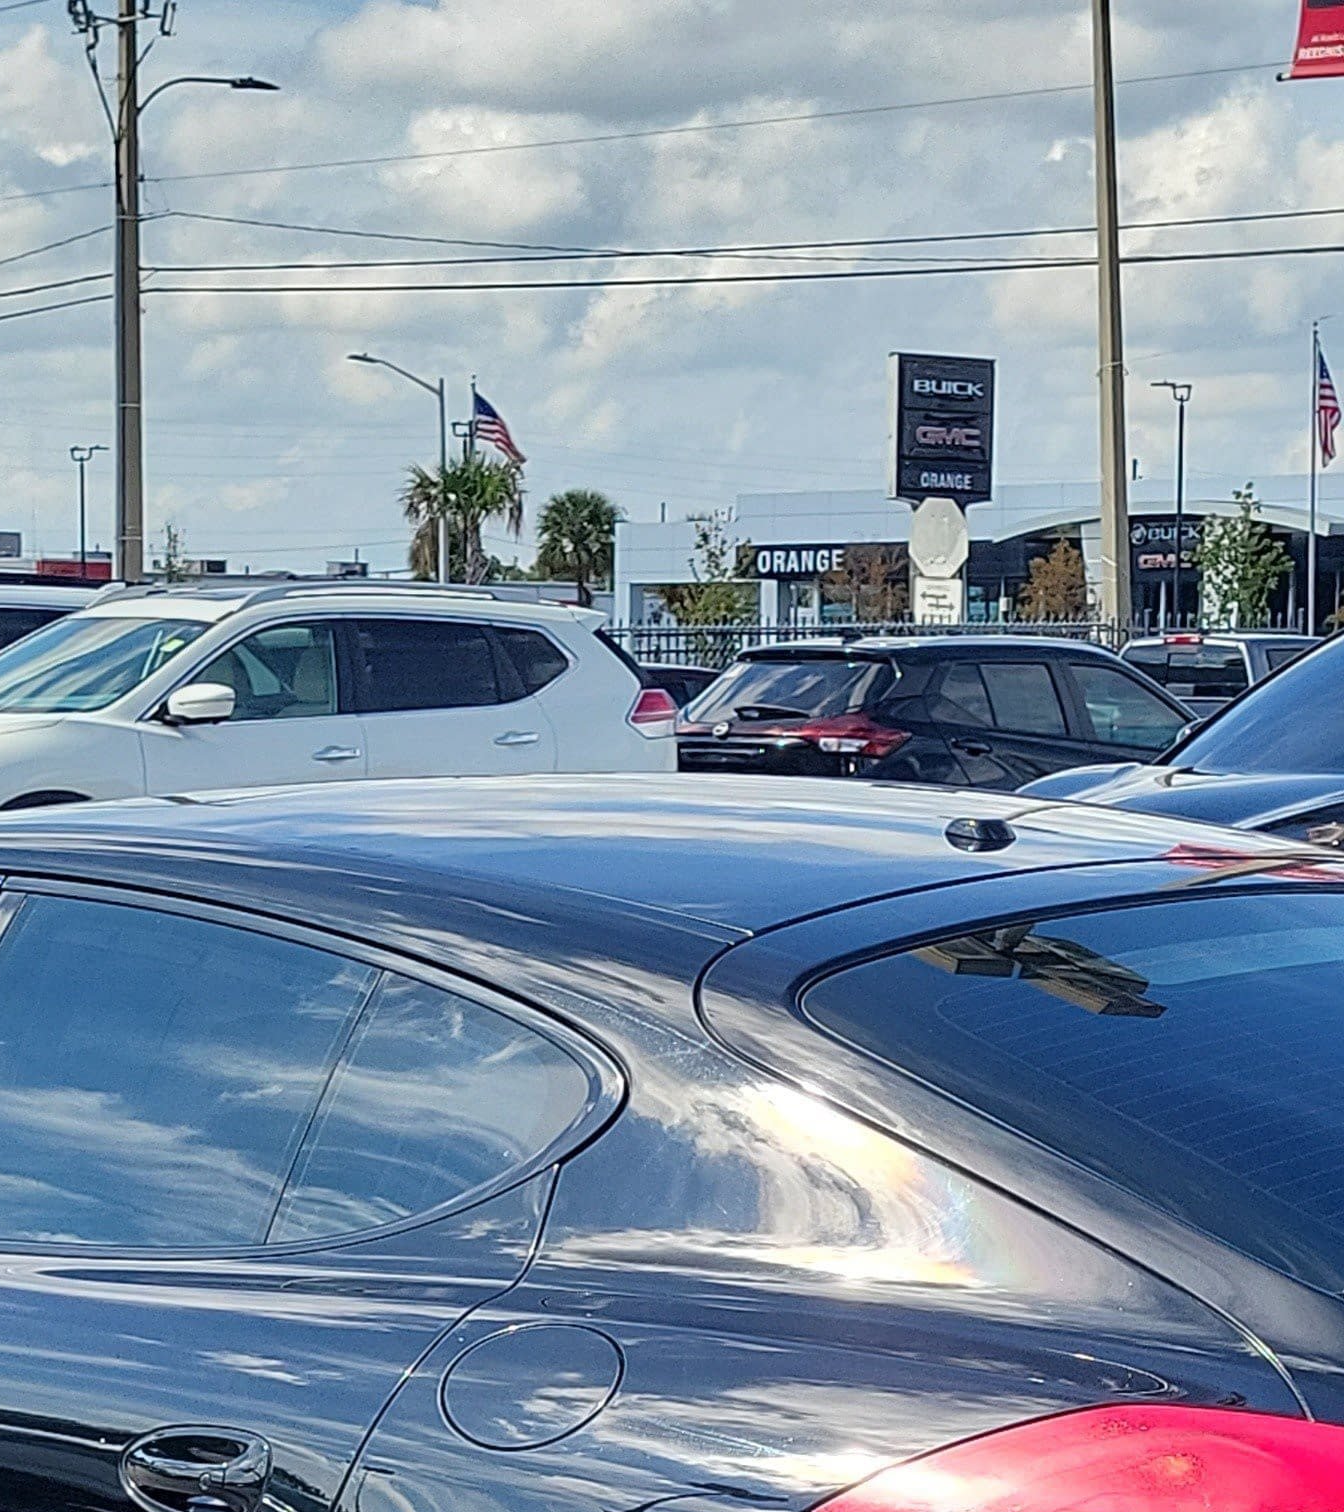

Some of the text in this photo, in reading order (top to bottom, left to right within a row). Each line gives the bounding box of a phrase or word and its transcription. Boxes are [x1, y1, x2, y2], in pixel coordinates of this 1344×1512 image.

[913, 379, 984, 396] BUICK
[916, 426, 981, 446] GMC
[920, 472, 972, 490] ORANGE
[757, 549, 846, 573] ORANGE
